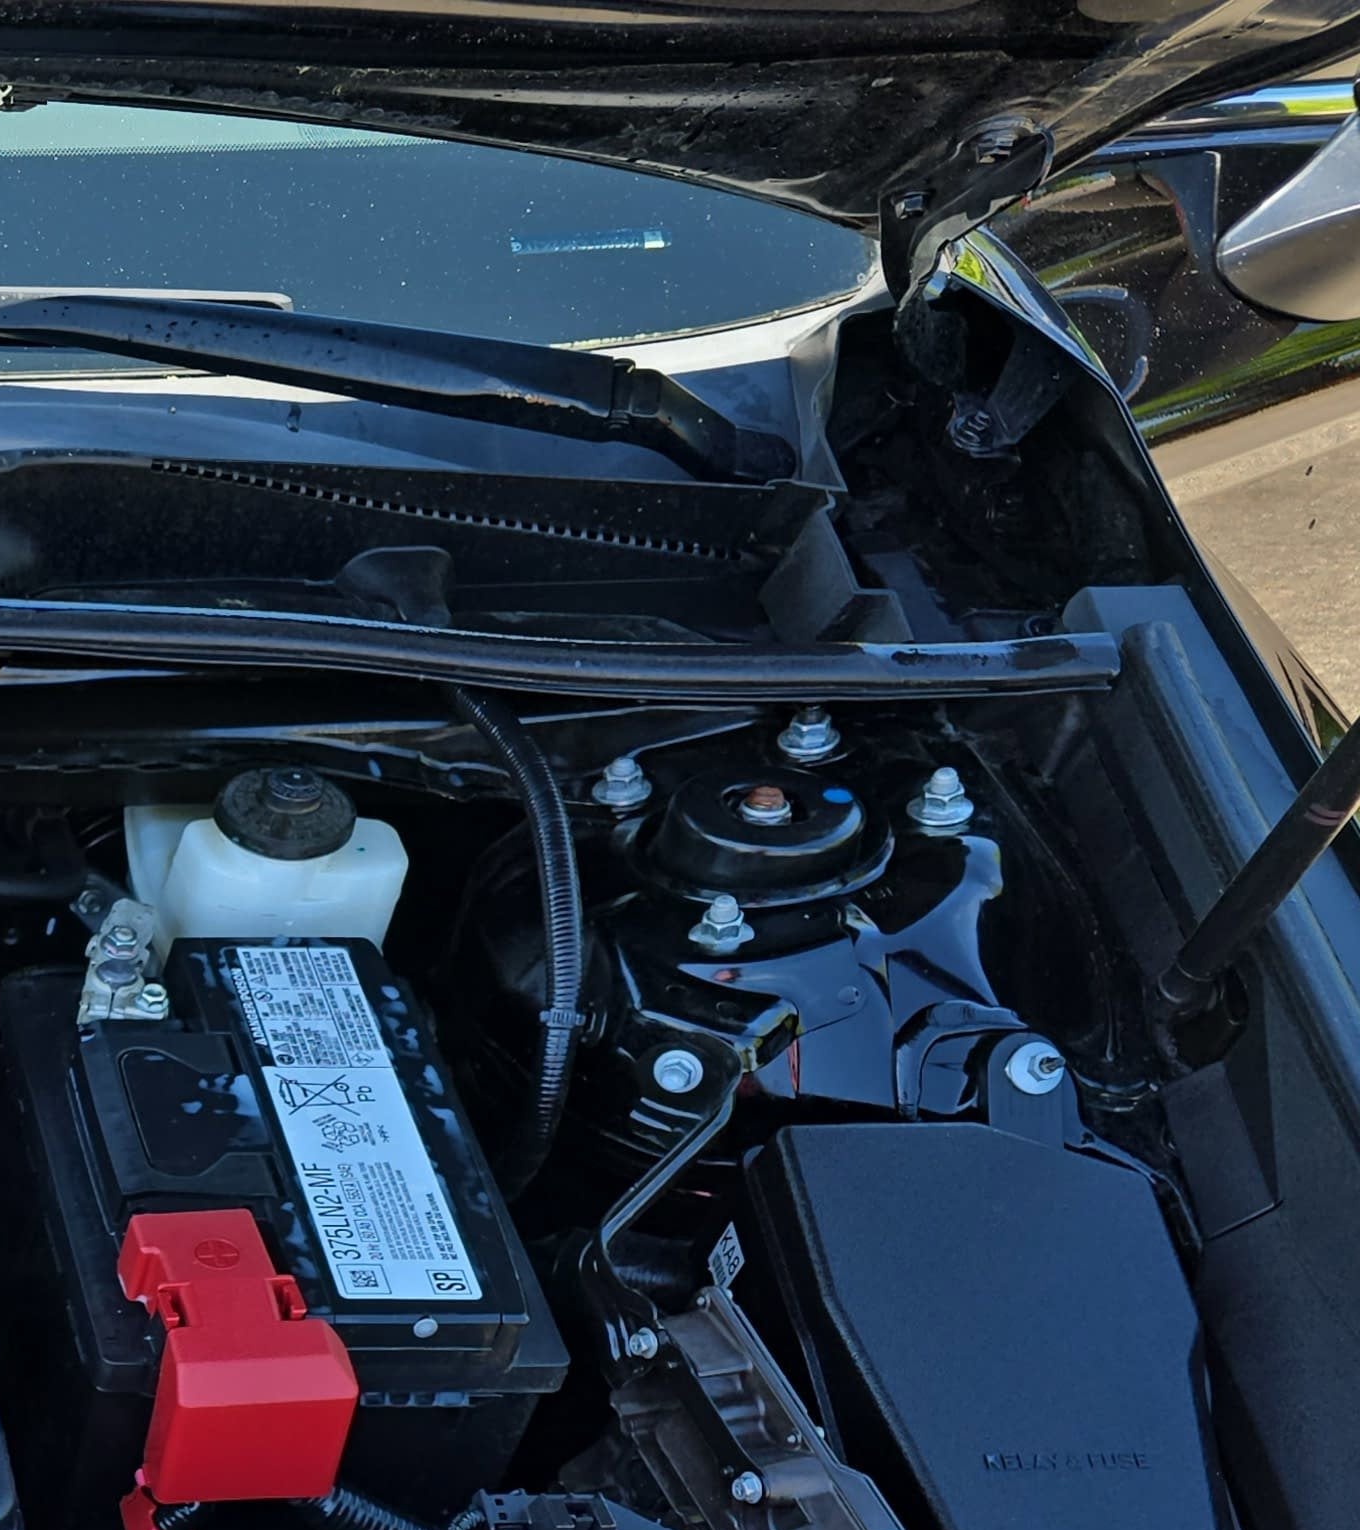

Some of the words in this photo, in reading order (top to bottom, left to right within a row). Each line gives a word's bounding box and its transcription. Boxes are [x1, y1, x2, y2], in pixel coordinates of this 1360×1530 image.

[356, 1085, 375, 1102] Pb
[302, 1162, 361, 1260] 375LN2-MF
[432, 1272, 467, 1292] SP
[982, 1452, 1058, 1472] RELAY
[1086, 1452, 1152, 1471] FUSE
